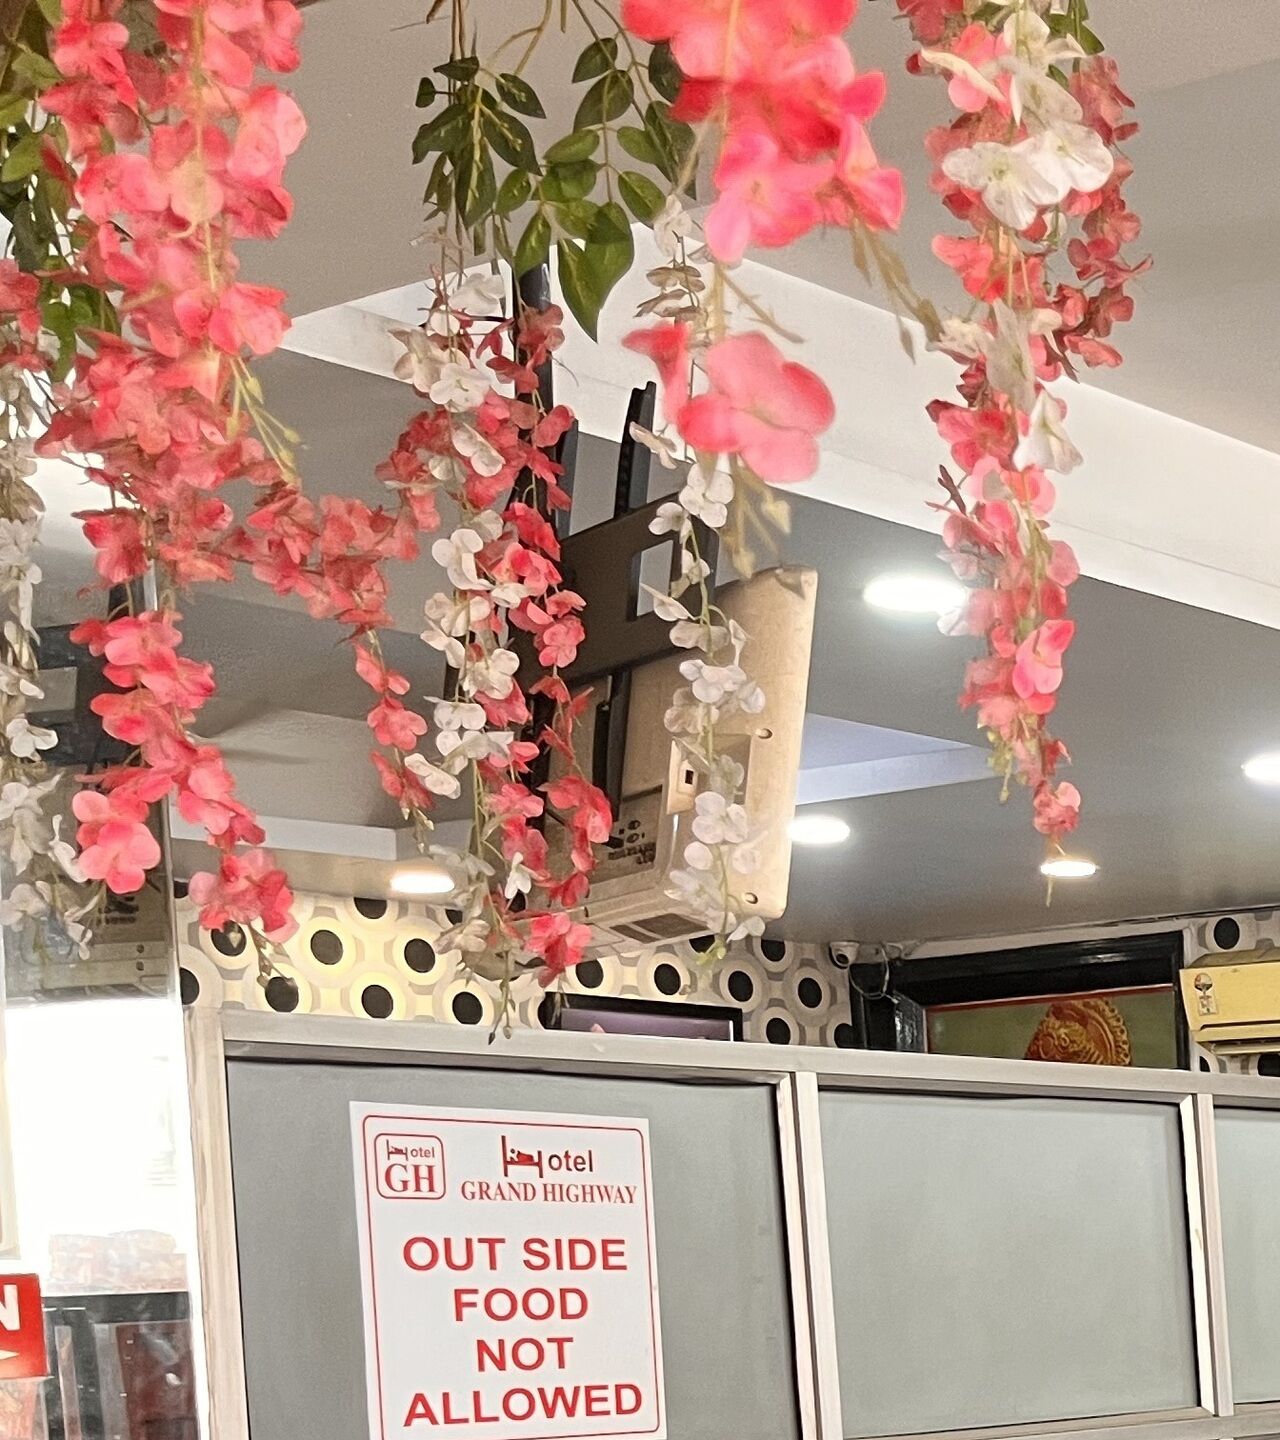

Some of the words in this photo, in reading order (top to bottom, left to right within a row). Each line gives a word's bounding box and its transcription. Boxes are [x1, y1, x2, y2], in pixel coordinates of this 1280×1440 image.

[501, 1135, 594, 1178] Hotel
[384, 1163, 438, 1194] GH
[461, 1180, 536, 1202] GRAND
[542, 1182, 638, 1205] HIGHWAY
[403, 1237, 505, 1271] OUT
[523, 1238, 627, 1271] SIDE
[454, 1287, 588, 1322] FOOD
[476, 1337, 574, 1373] NOT
[403, 1383, 643, 1427] ALLOWED
